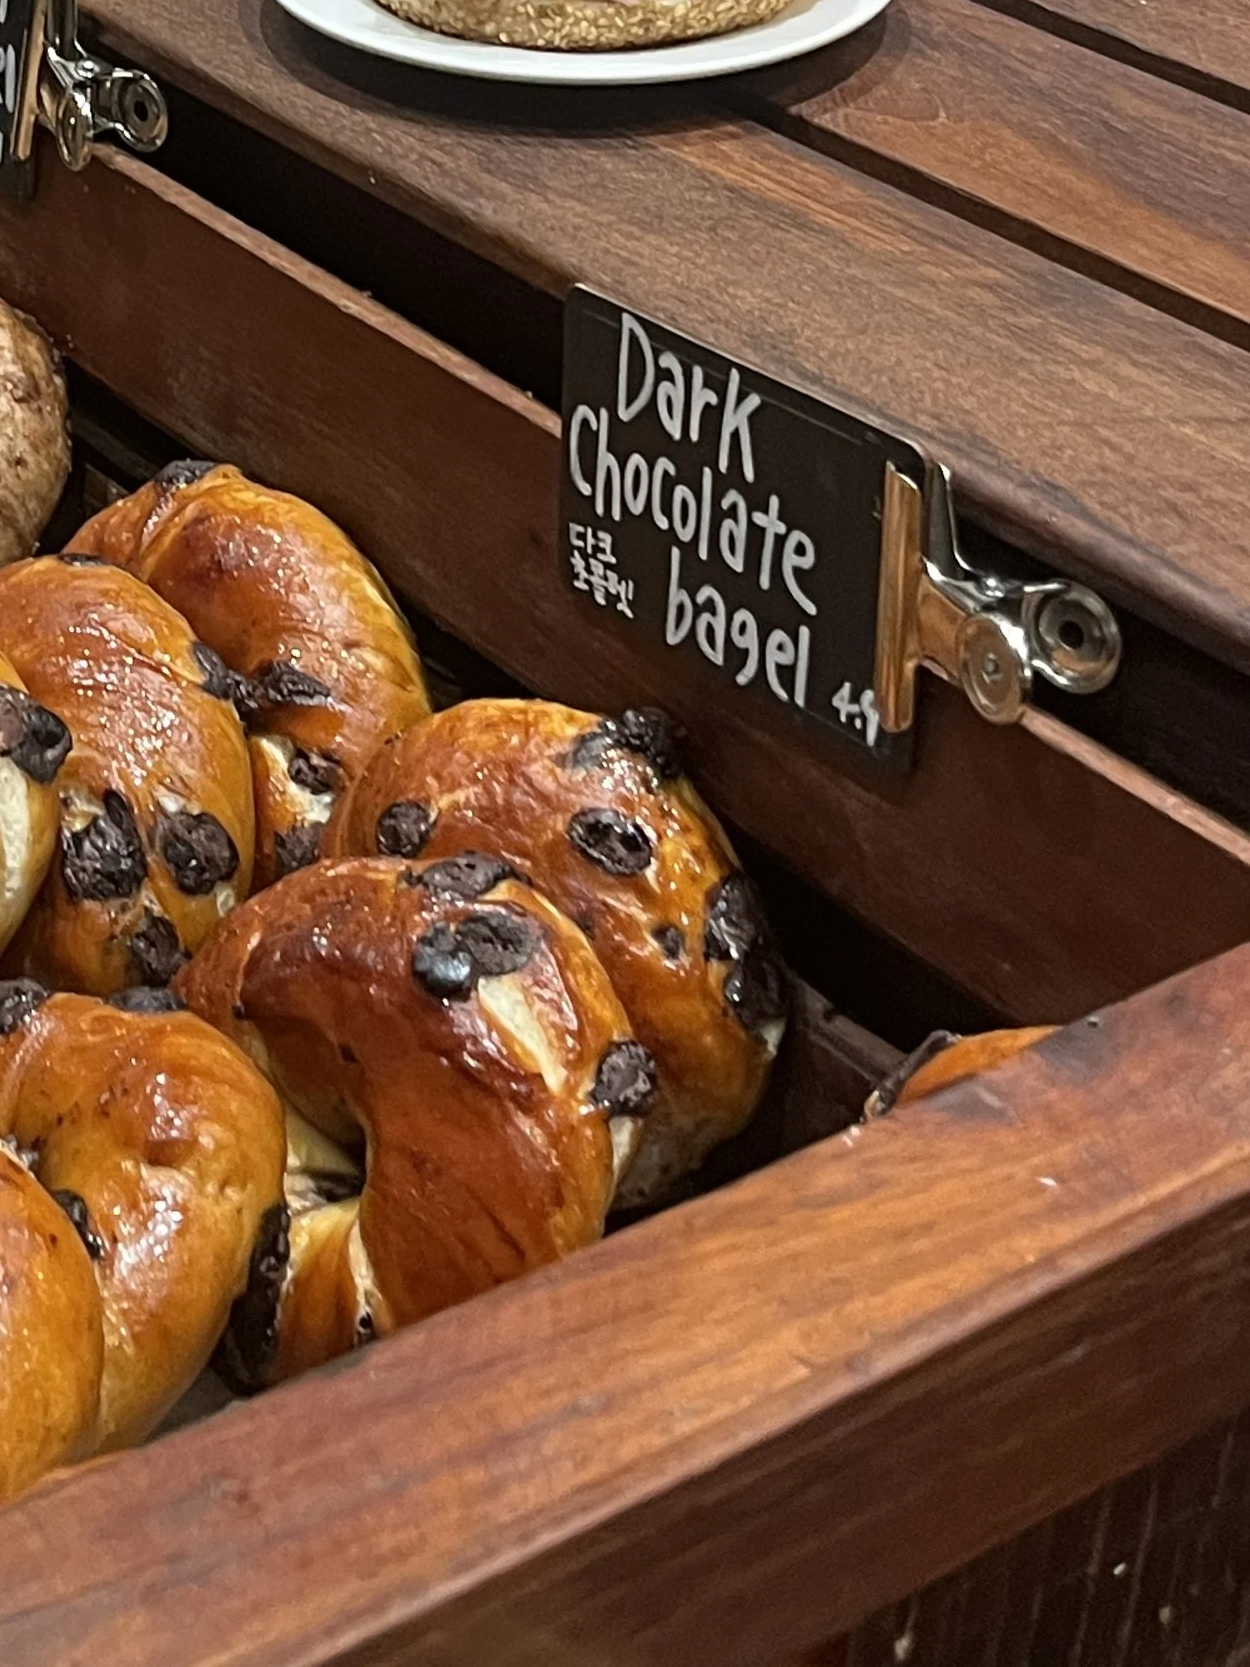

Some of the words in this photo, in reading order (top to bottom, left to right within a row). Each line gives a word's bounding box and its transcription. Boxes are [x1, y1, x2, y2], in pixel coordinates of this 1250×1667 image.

[617, 312, 762, 484] Dark
[568, 403, 818, 617] Chocolate
[665, 545, 811, 709] bagel
